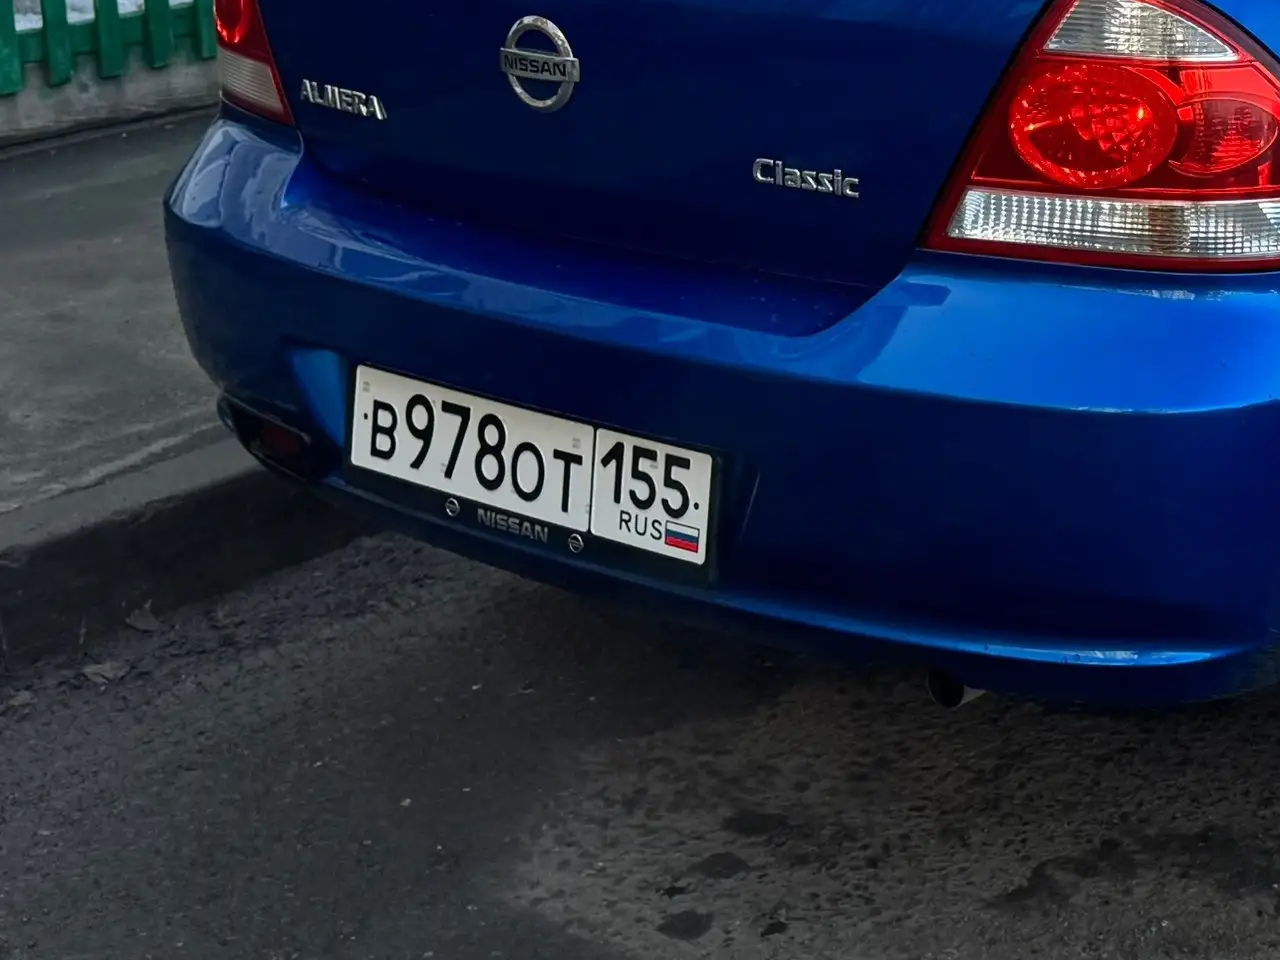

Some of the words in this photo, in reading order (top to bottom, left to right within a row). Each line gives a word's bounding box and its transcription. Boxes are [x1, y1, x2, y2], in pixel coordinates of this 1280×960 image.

[504, 54, 567, 77] NISSAN
[301, 78, 388, 120] ALMERA
[752, 157, 860, 198] Classic
[370, 393, 583, 513] В978ОТ
[600, 441, 690, 519] 155
[477, 507, 549, 544] NISSAN
[620, 510, 662, 541] RUS
